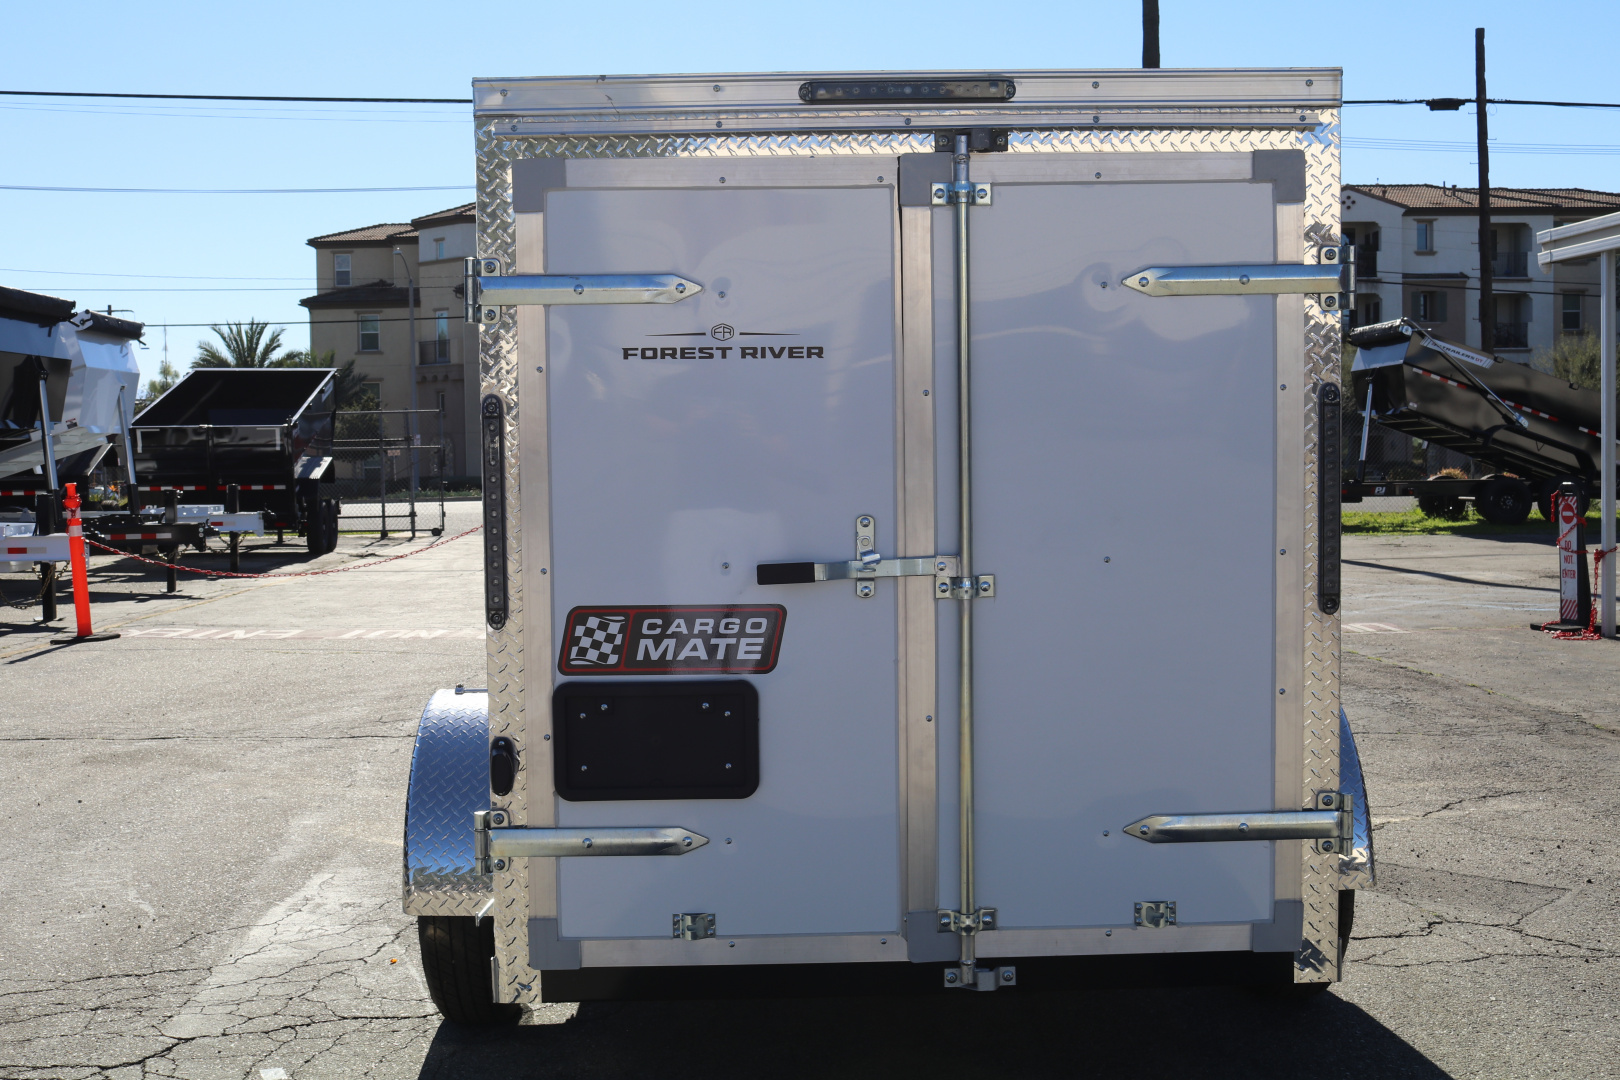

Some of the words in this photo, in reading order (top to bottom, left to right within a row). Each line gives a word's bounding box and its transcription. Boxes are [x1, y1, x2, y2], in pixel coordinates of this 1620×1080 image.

[713, 325, 733, 339] FR
[621, 346, 733, 360] FOREST
[739, 346, 825, 359] RIVER
[1564, 555, 1573, 564] NOT
[1562, 569, 1576, 578] ENTER
[641, 617, 768, 635] CARGO
[636, 637, 765, 661] MATE
